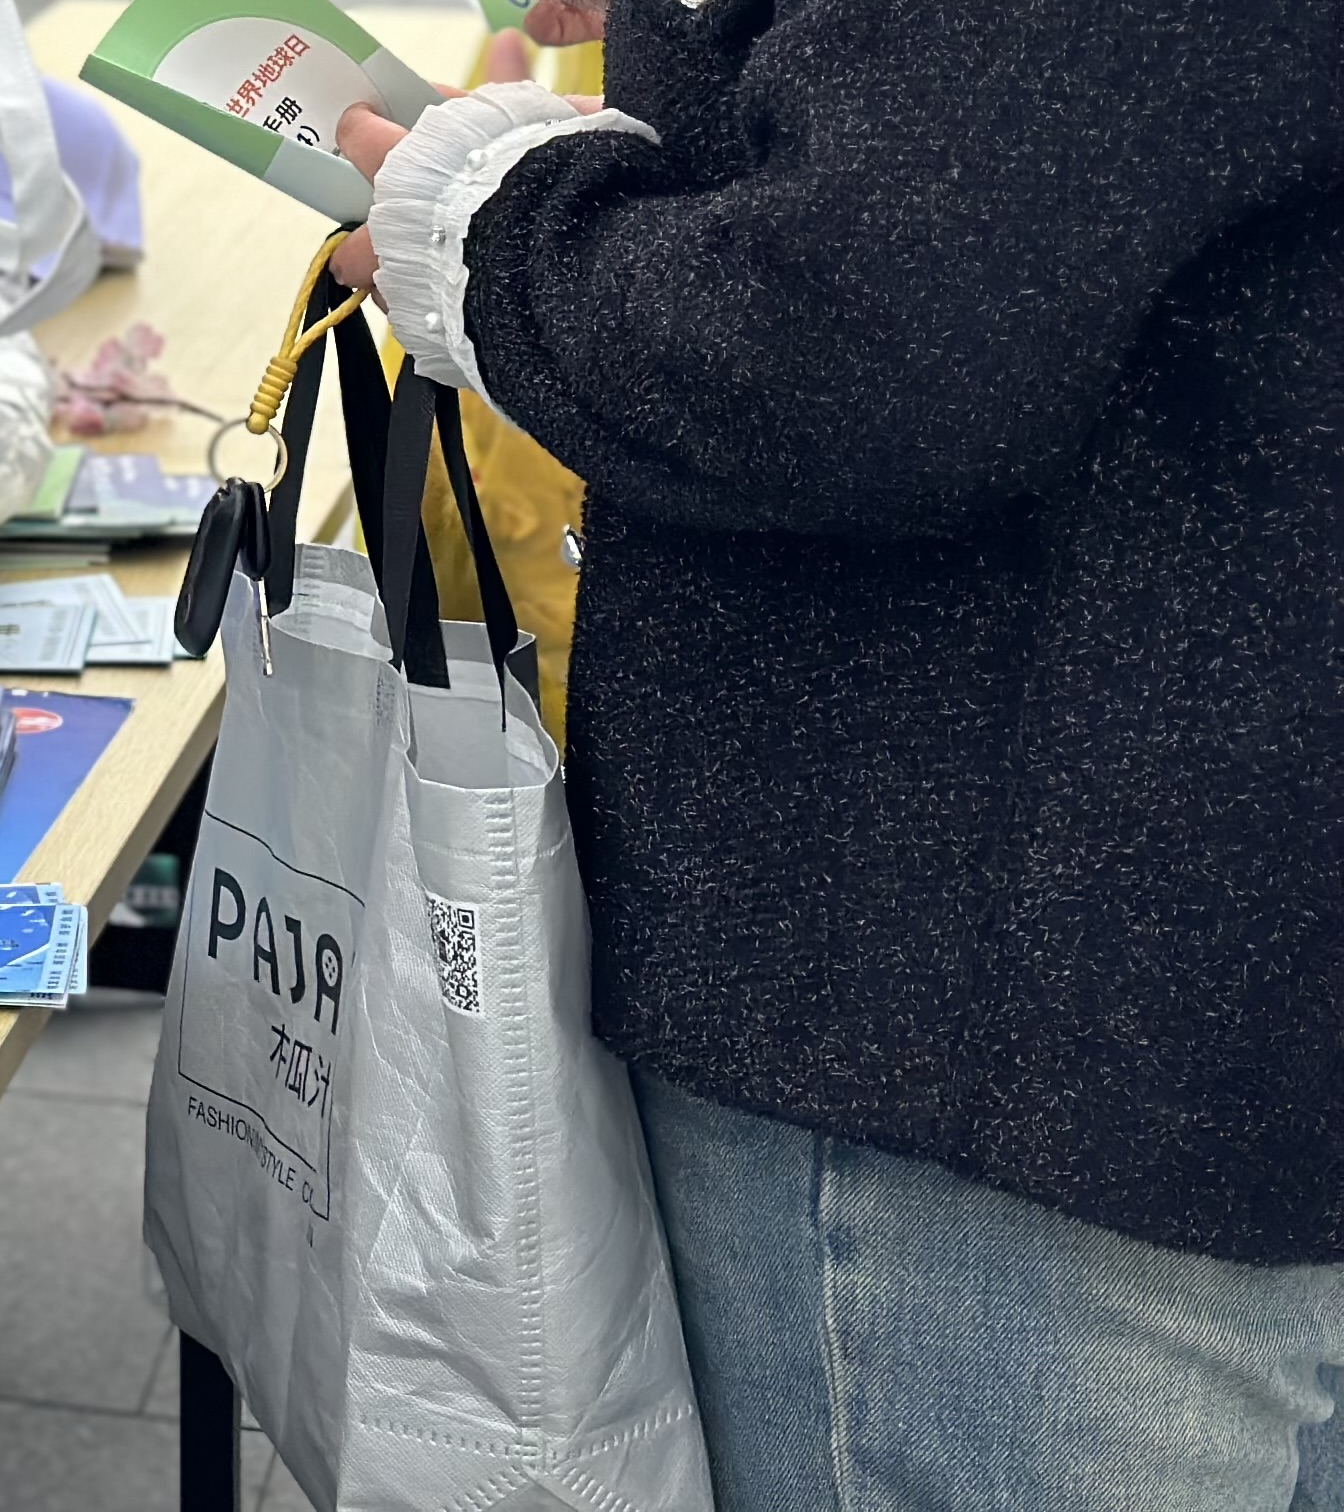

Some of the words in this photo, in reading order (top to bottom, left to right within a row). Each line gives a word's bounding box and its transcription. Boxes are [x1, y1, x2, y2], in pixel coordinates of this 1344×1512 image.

[225, 34, 311, 118] 世界地球日
